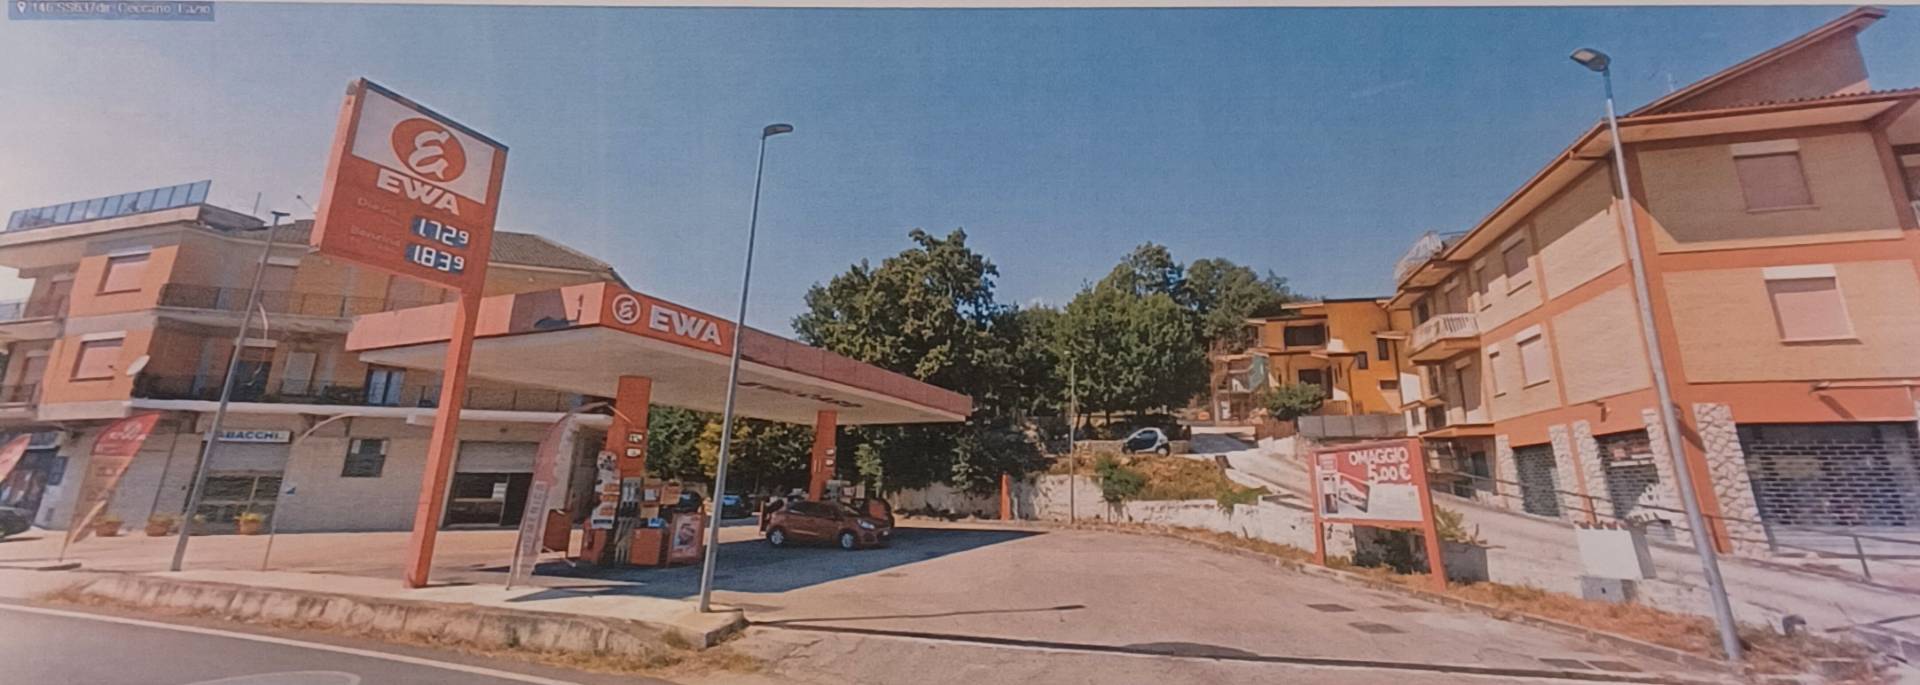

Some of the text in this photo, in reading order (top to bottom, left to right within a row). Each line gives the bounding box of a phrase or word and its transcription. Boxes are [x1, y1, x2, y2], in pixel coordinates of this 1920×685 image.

[377, 168, 460, 216] EWA
[648, 304, 722, 346] EWA
[1348, 446, 1409, 466] OMAGGIO
